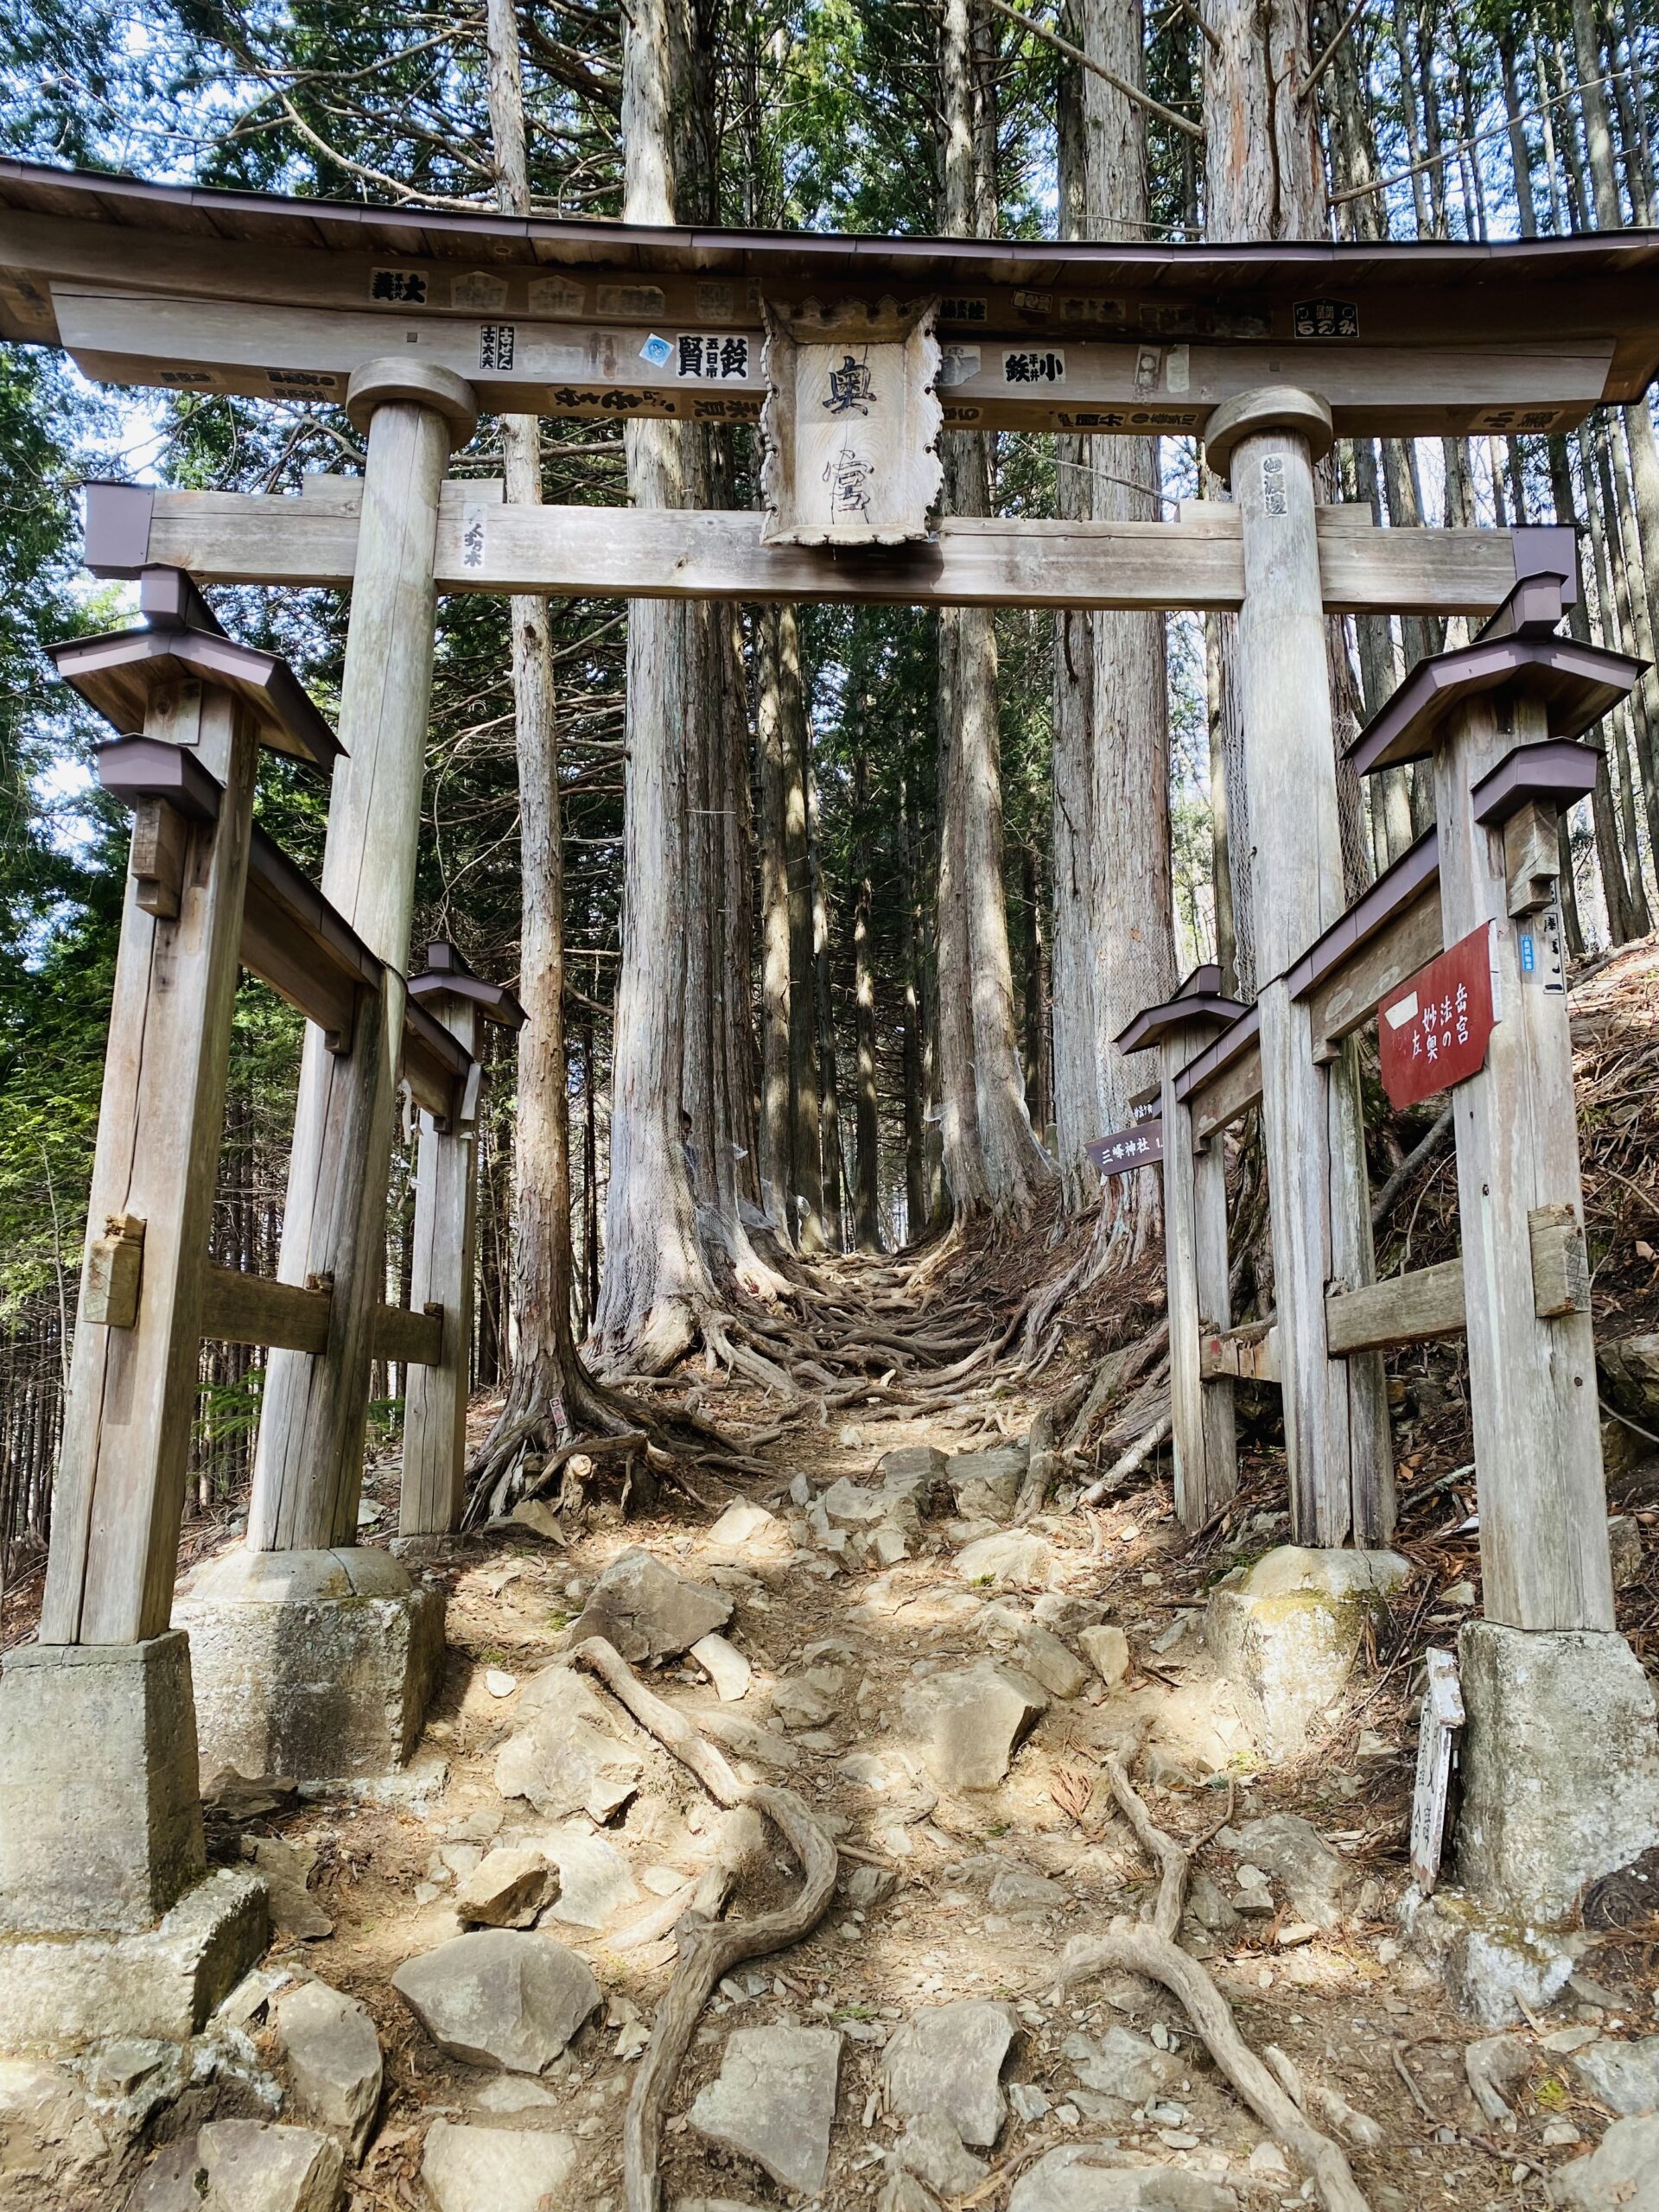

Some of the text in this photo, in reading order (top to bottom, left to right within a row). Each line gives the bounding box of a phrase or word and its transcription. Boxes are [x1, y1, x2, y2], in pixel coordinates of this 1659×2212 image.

[706, 338, 719, 378] 五日市
[823, 355, 876, 512] 奥宮
[1421, 982, 1468, 1034] 妙法岳
[1102, 1136, 1151, 1164] 三峰神社
